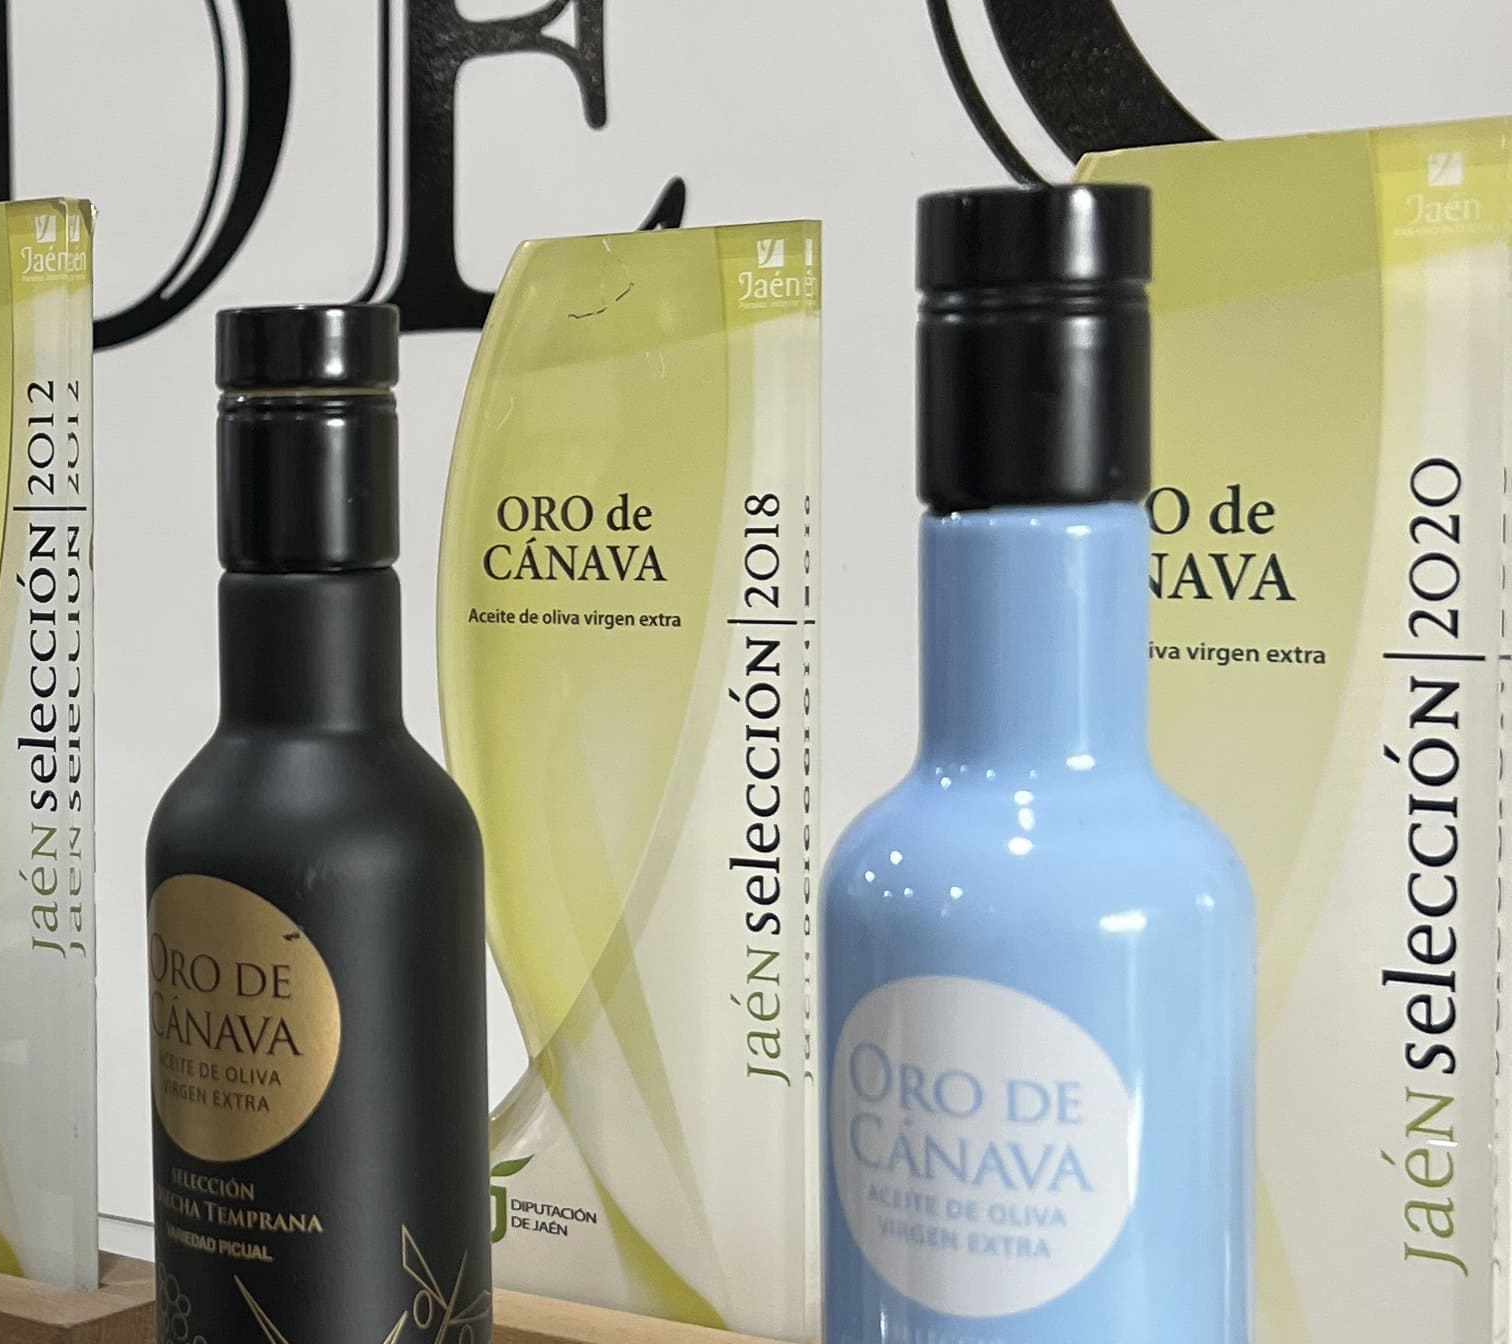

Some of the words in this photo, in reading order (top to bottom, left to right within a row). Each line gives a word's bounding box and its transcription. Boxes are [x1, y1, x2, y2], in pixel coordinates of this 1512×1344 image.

[738, 270, 799, 302] Jaén
[497, 495, 594, 532] ORO
[606, 493, 653, 532] de
[1209, 484, 1276, 536] de
[483, 538, 667, 583] CÁNAVA
[468, 608, 515, 625] Aceite
[519, 608, 538, 626] de
[542, 608, 580, 627] oliva
[583, 609, 635, 630] virgen
[639, 612, 682, 629] extra
[1186, 643, 1260, 667] virgen
[1266, 647, 1327, 666] extra
[150, 932, 221, 993] ORO
[236, 962, 292, 999] DE
[151, 991, 303, 1056] CÁNAVA
[199, 1062, 220, 1081] DE
[225, 1066, 282, 1087] OLIVA
[849, 1042, 983, 1119] ORO
[1006, 1079, 1082, 1126] DE
[213, 1090, 270, 1112] EXTRA
[849, 1112, 1095, 1192] CÁNAVA
[171, 1167, 255, 1201] SELECCIÓN
[203, 1200, 324, 1233] TEMPRANA
[510, 1198, 597, 1224] DIPUTACIÓN
[867, 1182, 936, 1215] ACEITE
[946, 1198, 978, 1223] DE
[988, 1203, 1068, 1228] OLIVA
[511, 1216, 531, 1230] DE
[532, 1219, 569, 1237] JAÉN
[877, 1215, 960, 1250] VIRGEN
[967, 1230, 1052, 1259] EXTRA
[219, 1238, 273, 1264] PICUAL
